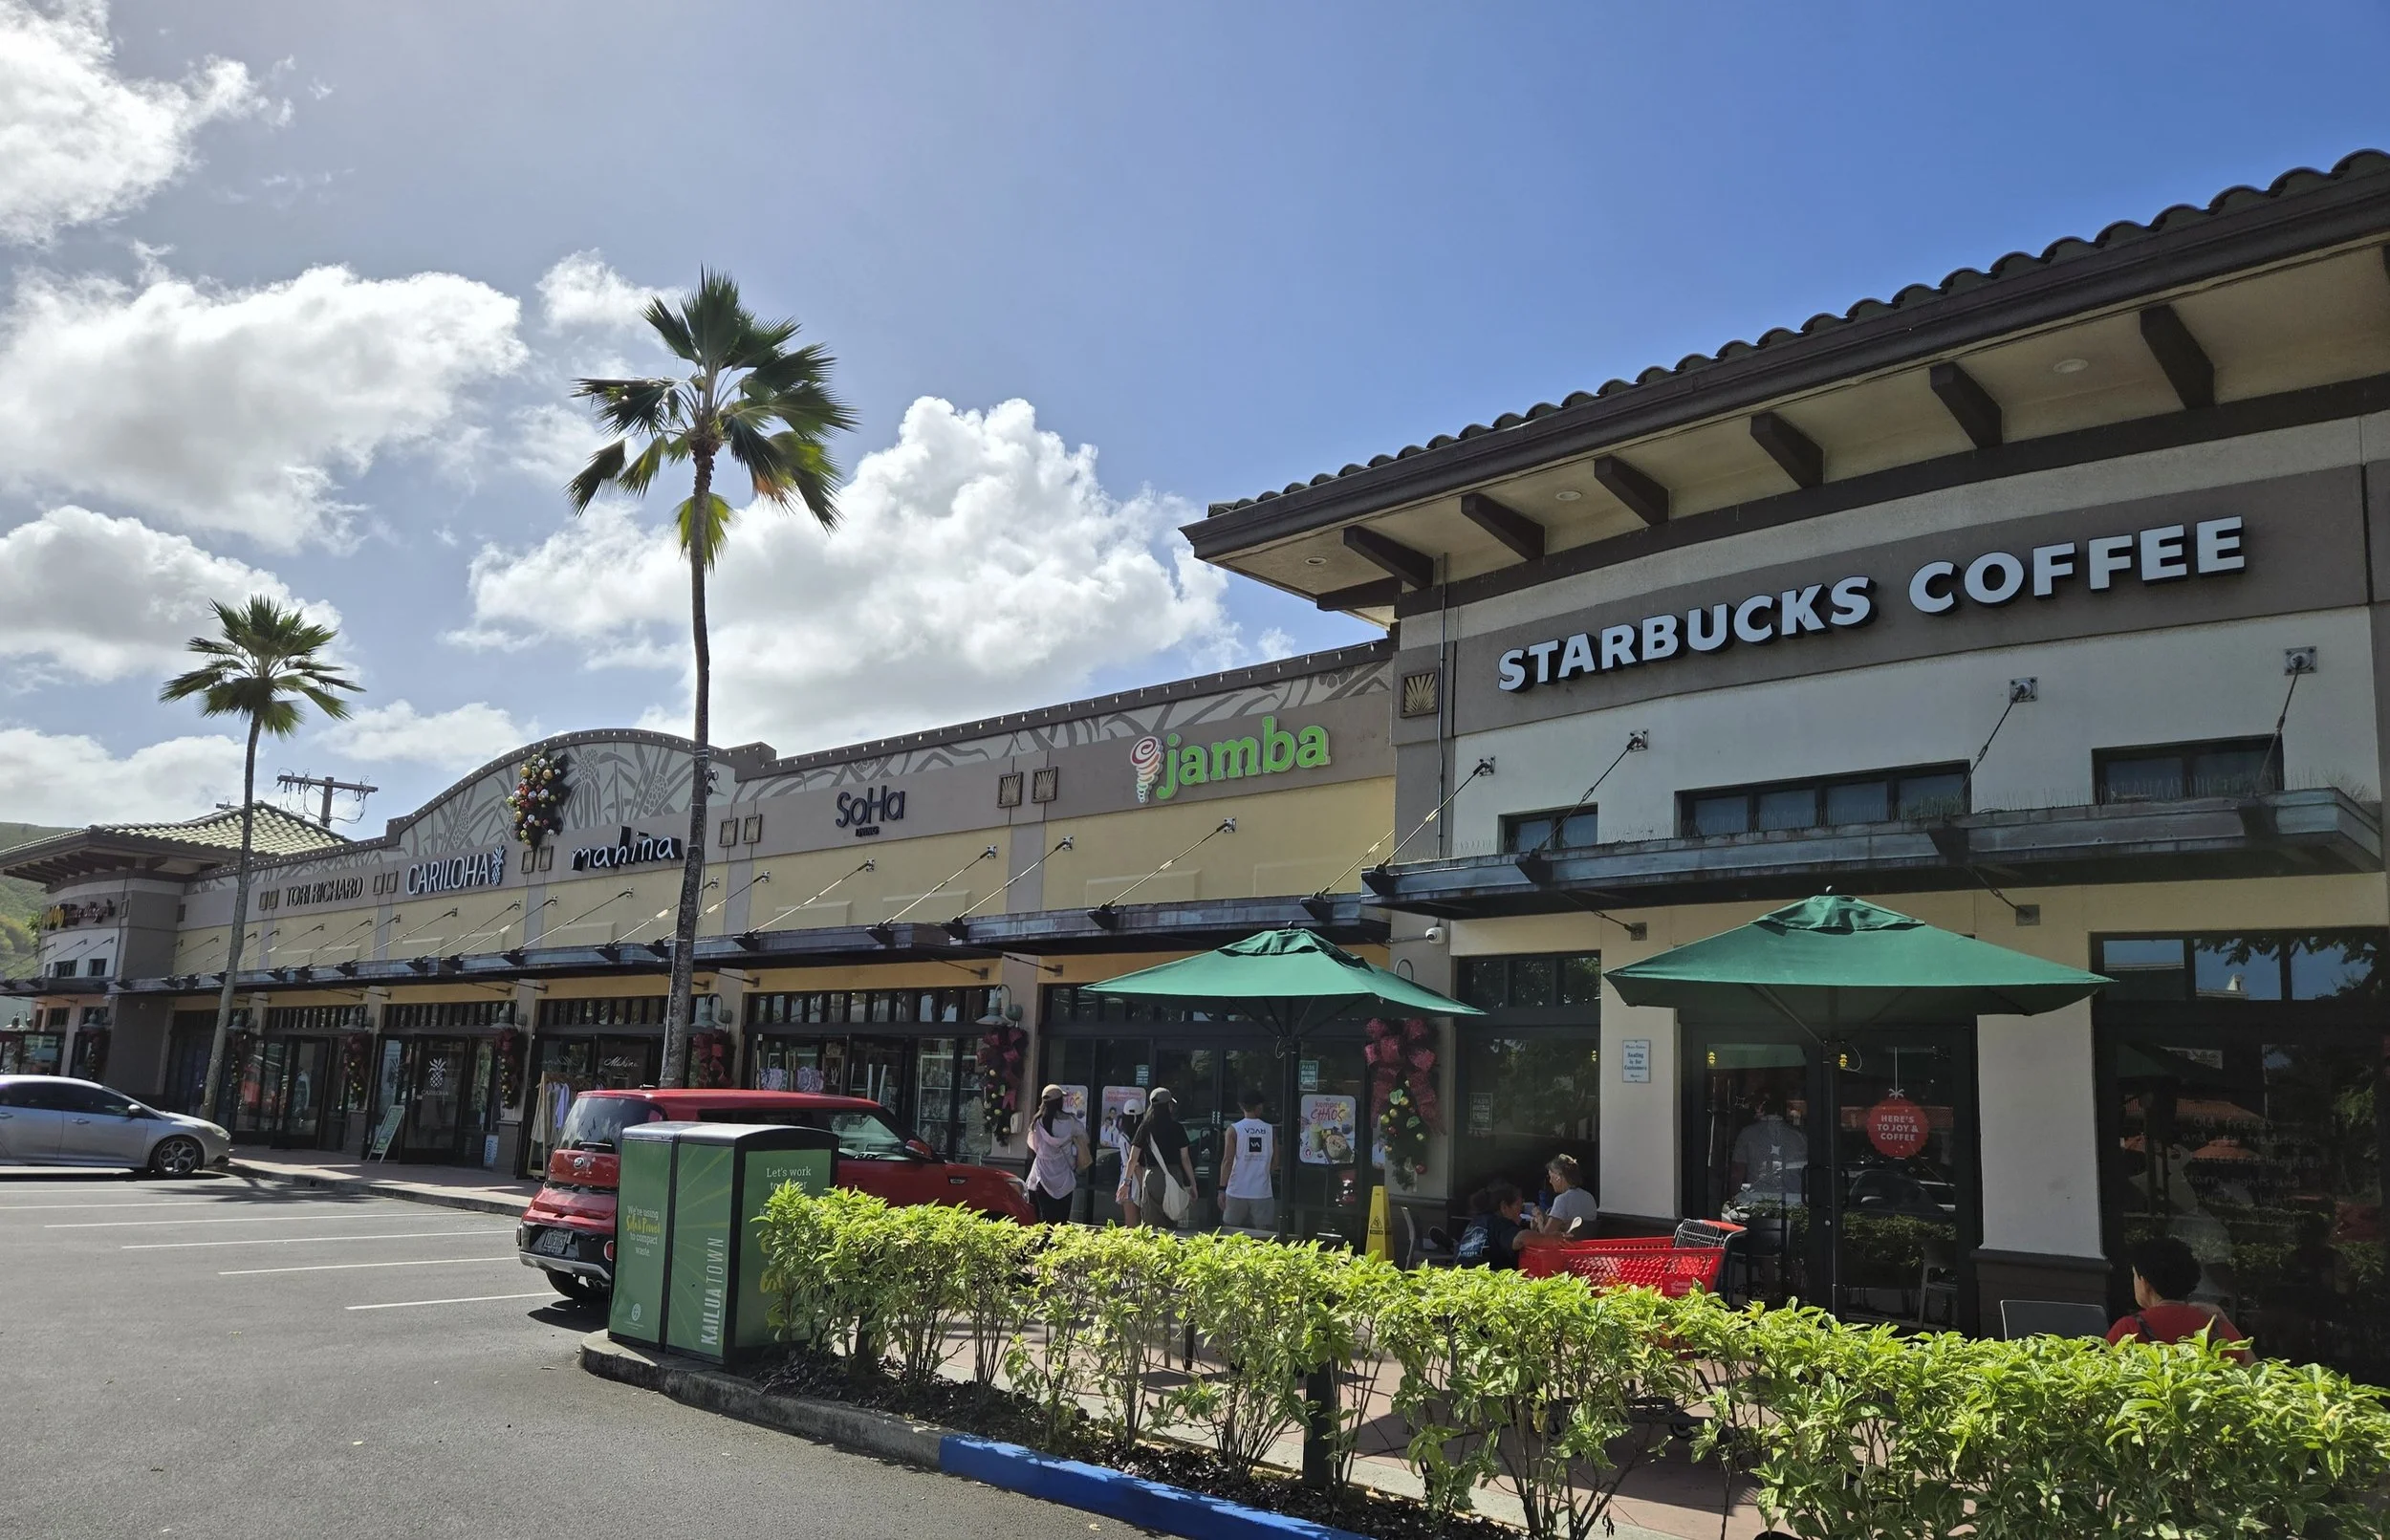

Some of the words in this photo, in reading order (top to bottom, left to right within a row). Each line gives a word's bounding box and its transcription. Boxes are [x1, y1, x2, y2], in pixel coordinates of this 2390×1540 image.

[1496, 574, 1879, 695] STARBUCKS
[1908, 515, 2249, 618] COFFEE
[1157, 716, 1333, 800] jamba
[836, 785, 905, 828] SoHa
[571, 825, 683, 871] mahina
[406, 853, 489, 896] CARILOHA
[286, 883, 311, 907] TORI
[311, 877, 365, 904] RICHARD
[1311, 1108, 1346, 1122] CHAOS
[1880, 1115, 1915, 1123] HERE'S
[1877, 1123, 1889, 1132] TO
[1891, 1124, 1909, 1133] JOY
[2193, 1116, 2216, 1129] Old
[1880, 1133, 1916, 1141] COFFEE
[767, 1166, 788, 1178] Let's
[789, 1166, 812, 1177] work
[643, 1208, 659, 1221] using
[636, 1234, 658, 1246] compact
